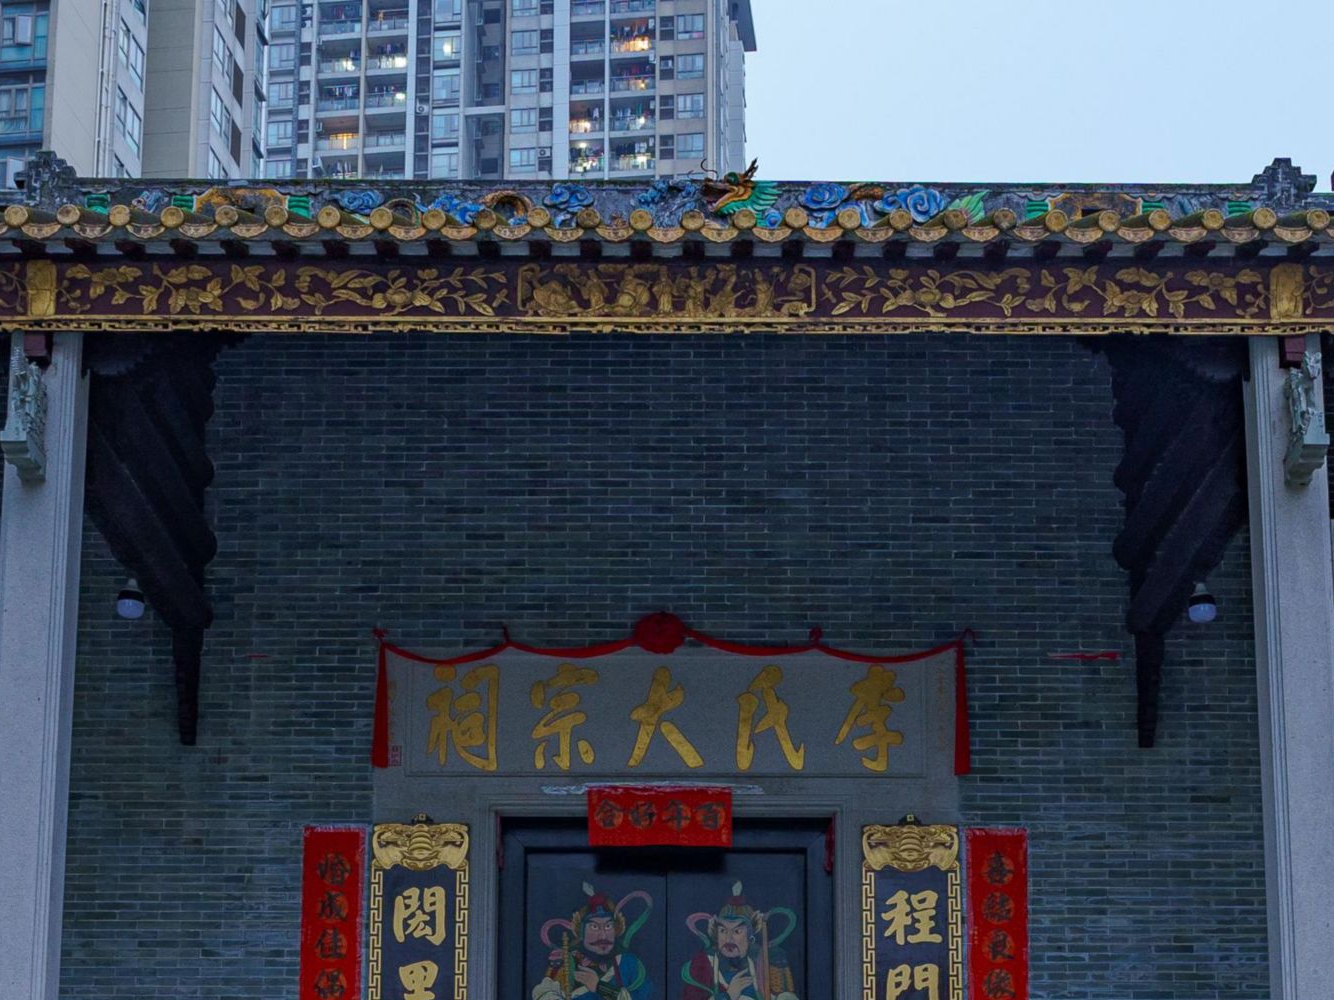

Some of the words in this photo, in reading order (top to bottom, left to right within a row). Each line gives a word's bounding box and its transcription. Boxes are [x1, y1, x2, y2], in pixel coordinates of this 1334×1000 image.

[426, 663, 906, 773] 李氏大宗祠
